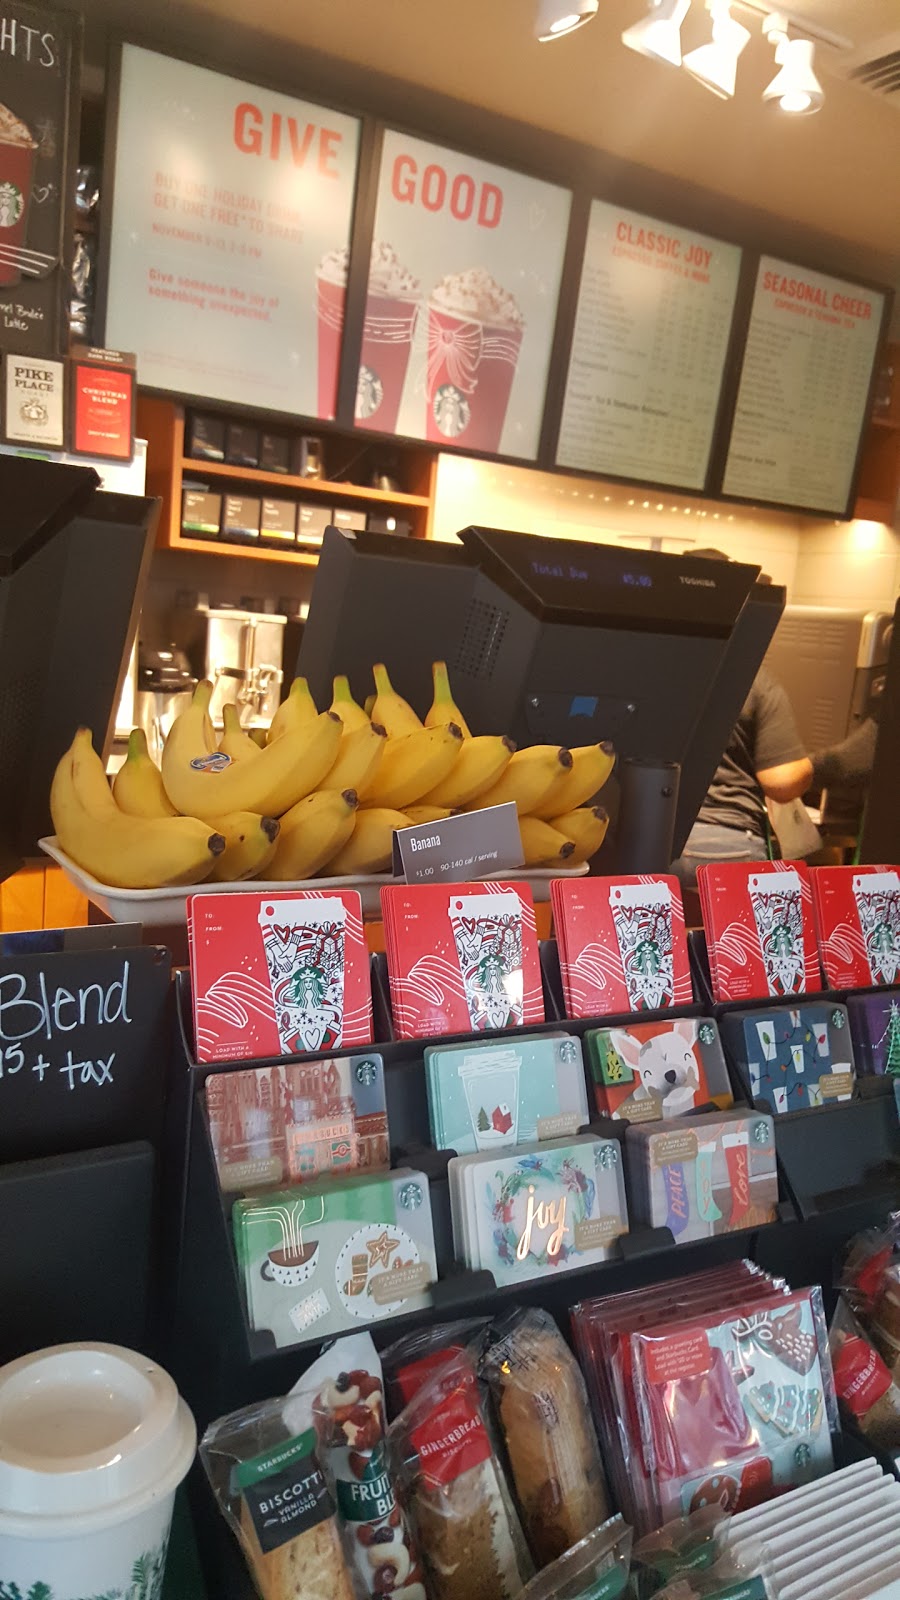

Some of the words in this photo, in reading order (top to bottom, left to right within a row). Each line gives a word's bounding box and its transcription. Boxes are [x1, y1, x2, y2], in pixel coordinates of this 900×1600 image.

[0, 18, 55, 67] HTS
[234, 102, 343, 180] GIVE
[155, 171, 183, 190] BUY
[213, 187, 262, 214] HOLIDAY
[391, 153, 504, 229] GOOD
[152, 222, 202, 243] NOVEMBER
[154, 191, 179, 210] GET
[250, 215, 264, 234] TO
[267, 222, 304, 245] SHARE
[616, 221, 681, 258] CLASSIC
[684, 244, 714, 270] JOY
[148, 267, 174, 284] Give
[177, 276, 226, 296] someone
[229, 286, 246, 301] the
[268, 297, 280, 308] of
[148, 285, 206, 309] something
[763, 271, 829, 309] SEASONAL
[831, 293, 873, 321] CHEER
[4, 316, 29, 331] Latte
[14, 366, 54, 382] PIKE
[14, 379, 54, 392] PLACE
[81, 387, 128, 400] CHRISTMAS
[91, 395, 118, 405] BLEND
[679, 575, 717, 588] TOSHIBA
[410, 835, 442, 852] Banana
[416, 867, 434, 877] $1.00
[440, 859, 464, 873] 90-140
[464, 855, 474, 866] cal
[478, 850, 498, 863] serving
[0, 961, 132, 1041] Blend
[60, 1051, 115, 1090] tax
[668, 1164, 688, 1218] PEACE
[516, 1184, 570, 1261] joy
[257, 1443, 303, 1472] STARBUCKS
[260, 1469, 323, 1514] BISCOTTI
[278, 1493, 315, 1515] VANILLA
[281, 1499, 317, 1523] ALMOND
